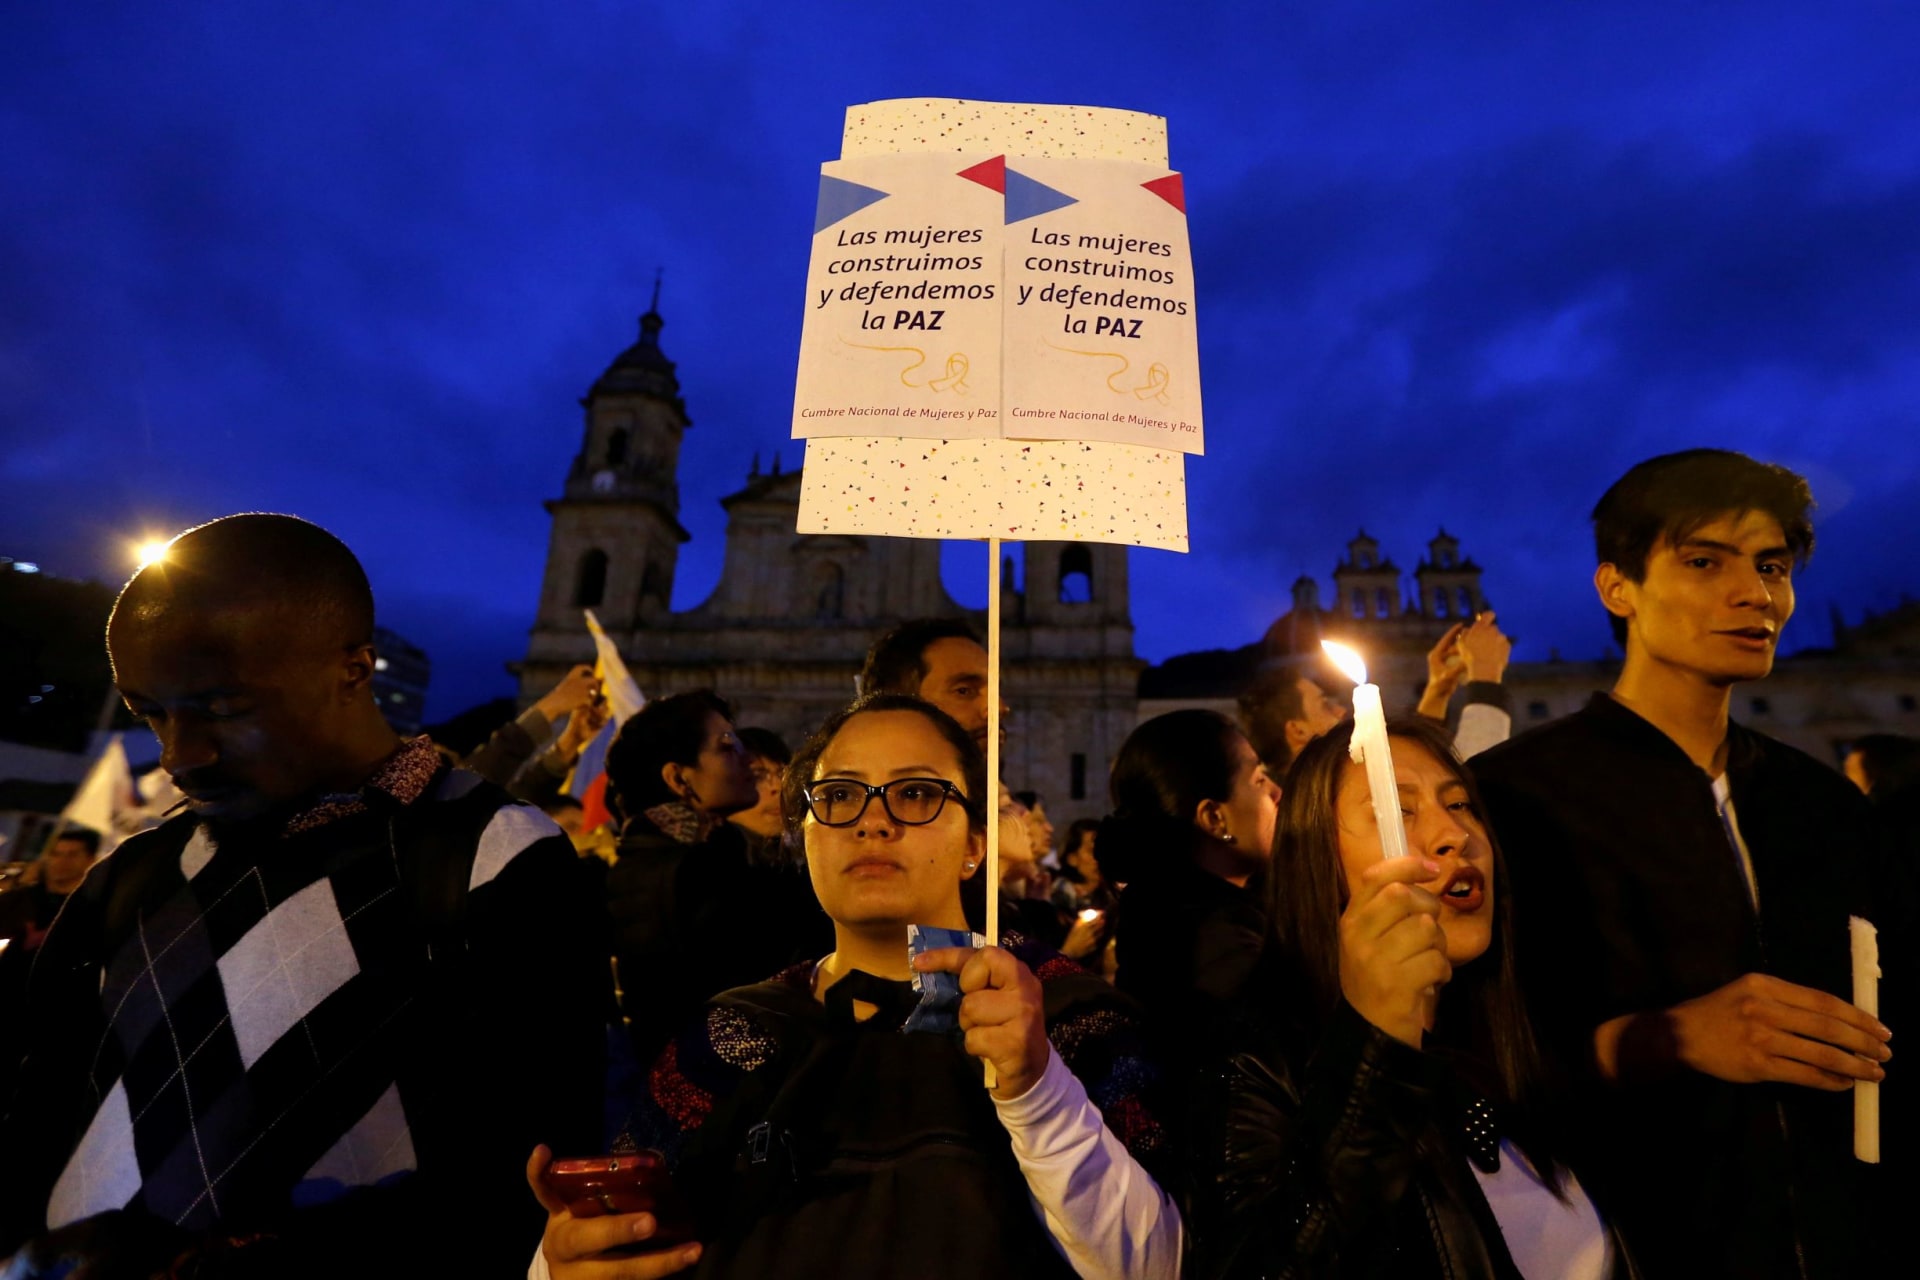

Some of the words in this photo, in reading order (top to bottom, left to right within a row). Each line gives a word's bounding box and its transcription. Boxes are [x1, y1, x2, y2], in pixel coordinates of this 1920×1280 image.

[837, 230, 877, 246] Las
[884, 226, 983, 249] mujeres
[1032, 228, 1070, 246] Las
[1079, 234, 1171, 256] mujeres
[828, 253, 982, 274] construimos
[1025, 253, 1174, 284] construimos
[817, 289, 833, 309] y
[840, 280, 995, 305] defendemos
[1017, 285, 1033, 305] y
[1040, 282, 1187, 316] defendemos
[862, 310, 885, 329] la
[893, 310, 945, 330] PAZ
[1064, 314, 1086, 333] la
[1095, 316, 1143, 338] PAZ
[802, 407, 846, 418] Cumbre
[848, 406, 900, 417] Nacional
[903, 407, 917, 418] de
[920, 407, 965, 421] Mujeres
[967, 410, 975, 421] y
[977, 408, 998, 418] Paz
[1012, 407, 1057, 419] Cumbre
[1059, 409, 1110, 422] Nacional
[1112, 412, 1126, 424] de
[1128, 414, 1169, 429] Mujeres
[1171, 422, 1178, 433] y
[1180, 421, 1198, 434] Paz
